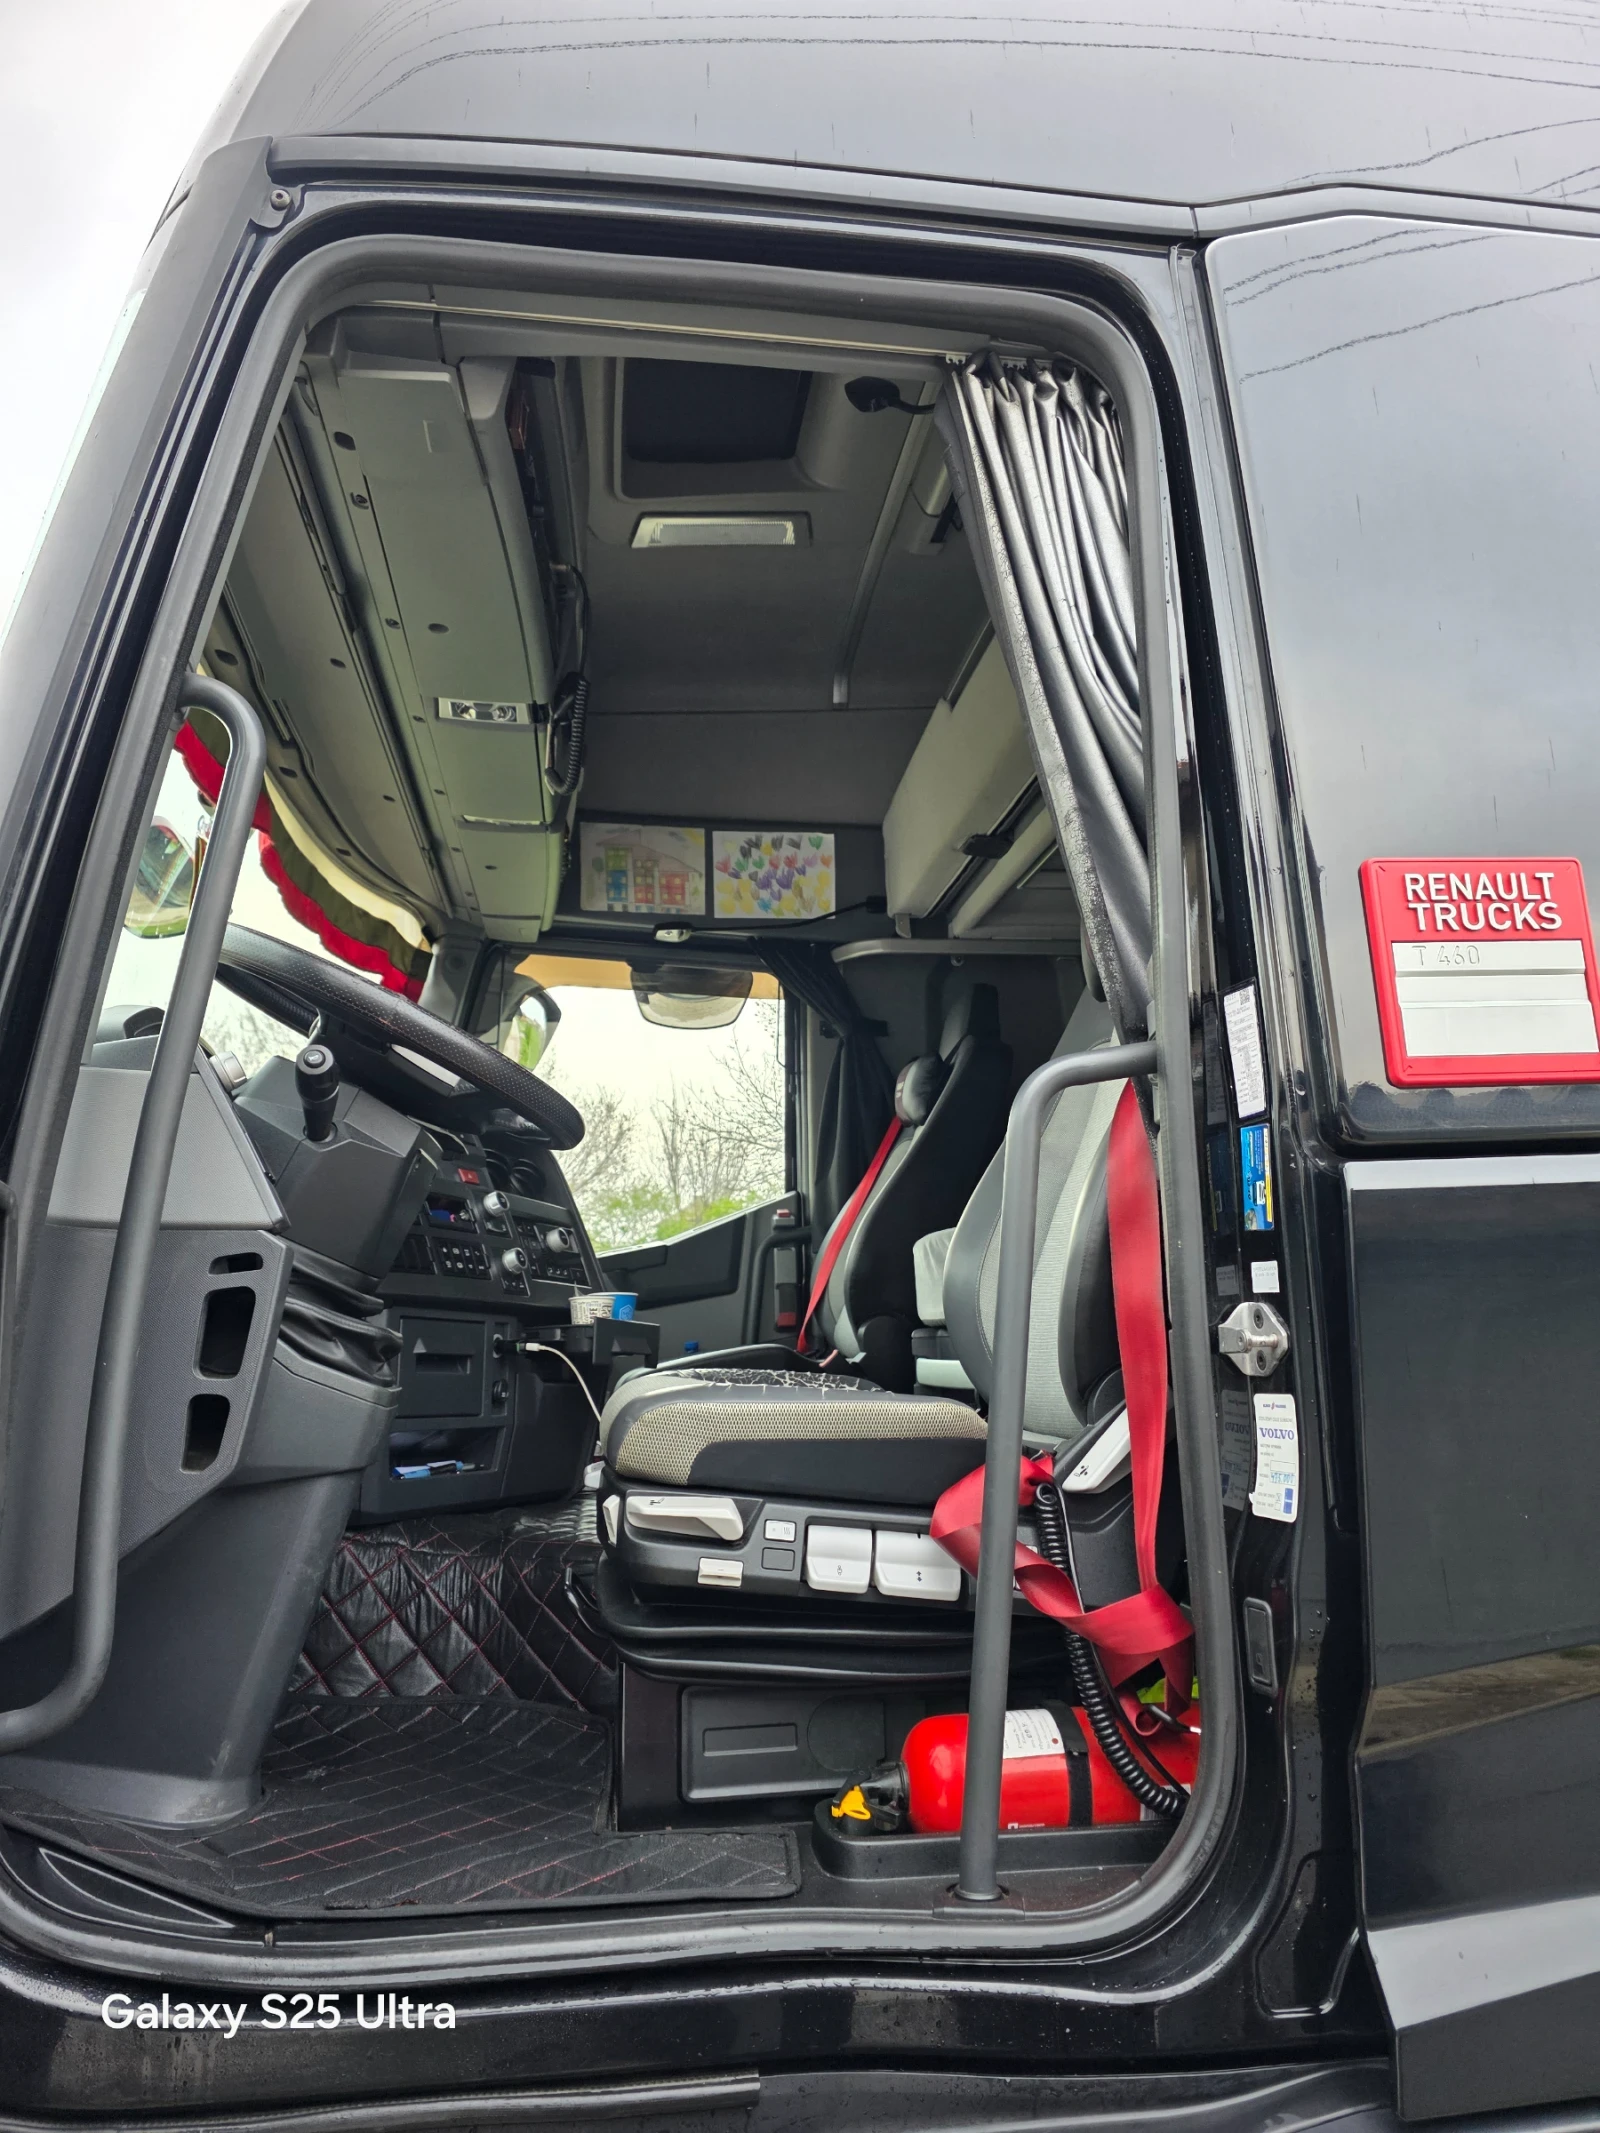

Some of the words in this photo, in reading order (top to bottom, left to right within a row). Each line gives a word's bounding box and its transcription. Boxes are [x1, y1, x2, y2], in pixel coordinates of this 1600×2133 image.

[1404, 872, 1555, 901] RENAULT
[1408, 902, 1563, 931] TRUCKS
[1412, 945, 1427, 966] T
[1437, 945, 1481, 966] 460
[1259, 1427, 1294, 1440] VOLVO
